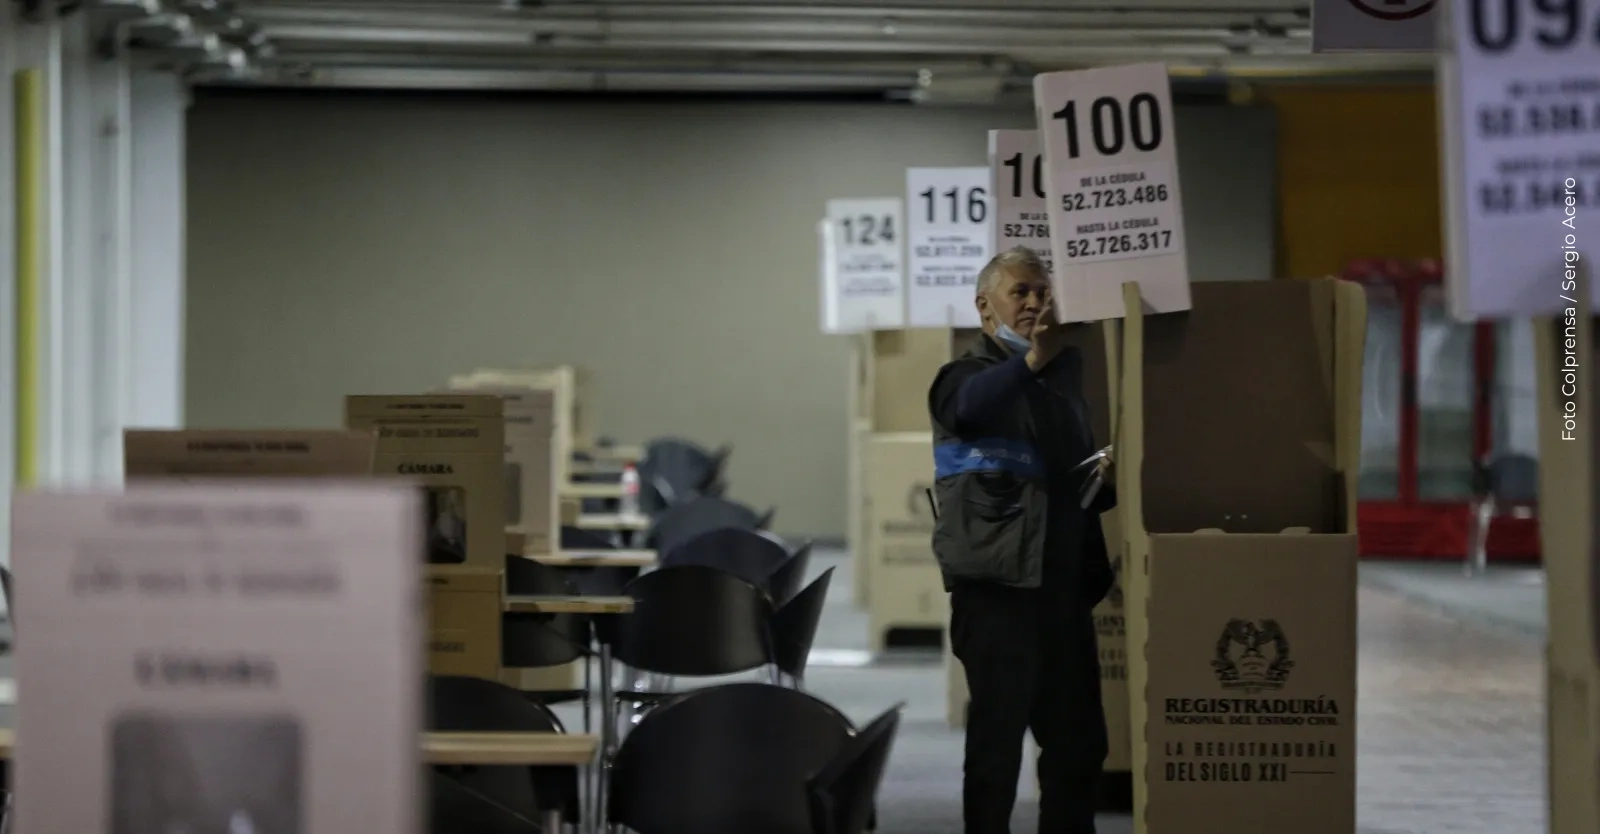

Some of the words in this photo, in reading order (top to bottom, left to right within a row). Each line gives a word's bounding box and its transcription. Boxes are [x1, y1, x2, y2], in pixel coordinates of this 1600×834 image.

[1470, 0, 1600, 54] 09
[1052, 92, 1162, 159] 100
[1003, 152, 1046, 198] 10
[1080, 177, 1092, 188] DE
[1095, 175, 1107, 186] LA
[919, 186, 987, 224] 116
[1062, 184, 1168, 212] 52.723.486
[842, 214, 896, 245] 124
[1076, 222, 1106, 235] HASTA
[1108, 220, 1119, 231] LA
[1067, 230, 1171, 258] 52.726.317
[1165, 694, 1339, 714] REGISTRADURÍA
[1165, 715, 1225, 725] NACIONAL
[1230, 715, 1250, 725] DEL
[1257, 715, 1304, 726] ESTADO
[1307, 715, 1338, 726] CIVIL
[1165, 742, 1183, 756] LA
[1194, 740, 1336, 757] REGISTRADURÍA
[1165, 762, 1197, 782] DEL
[1200, 762, 1251, 782] SIGLO
[1258, 763, 1287, 782] XXI
